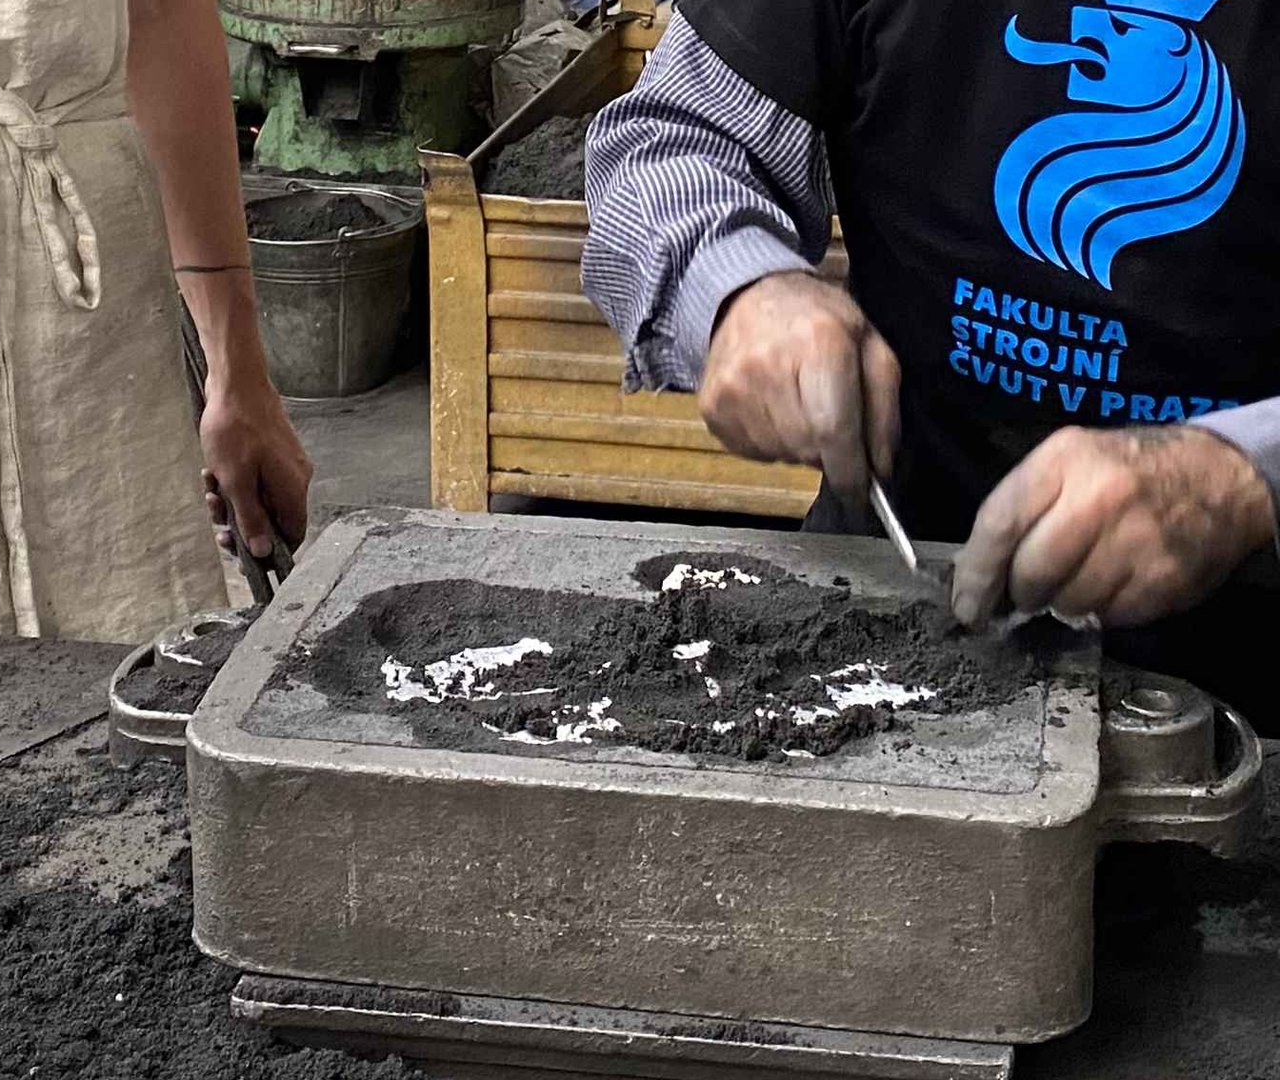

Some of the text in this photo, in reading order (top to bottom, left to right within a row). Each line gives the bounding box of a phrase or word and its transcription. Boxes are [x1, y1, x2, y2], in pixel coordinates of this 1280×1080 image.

[953, 277, 1128, 347] FAKULTA
[949, 341, 1048, 402] ČVUT
[1058, 383, 1087, 412] V
[951, 314, 1123, 383] STROJNÍ
